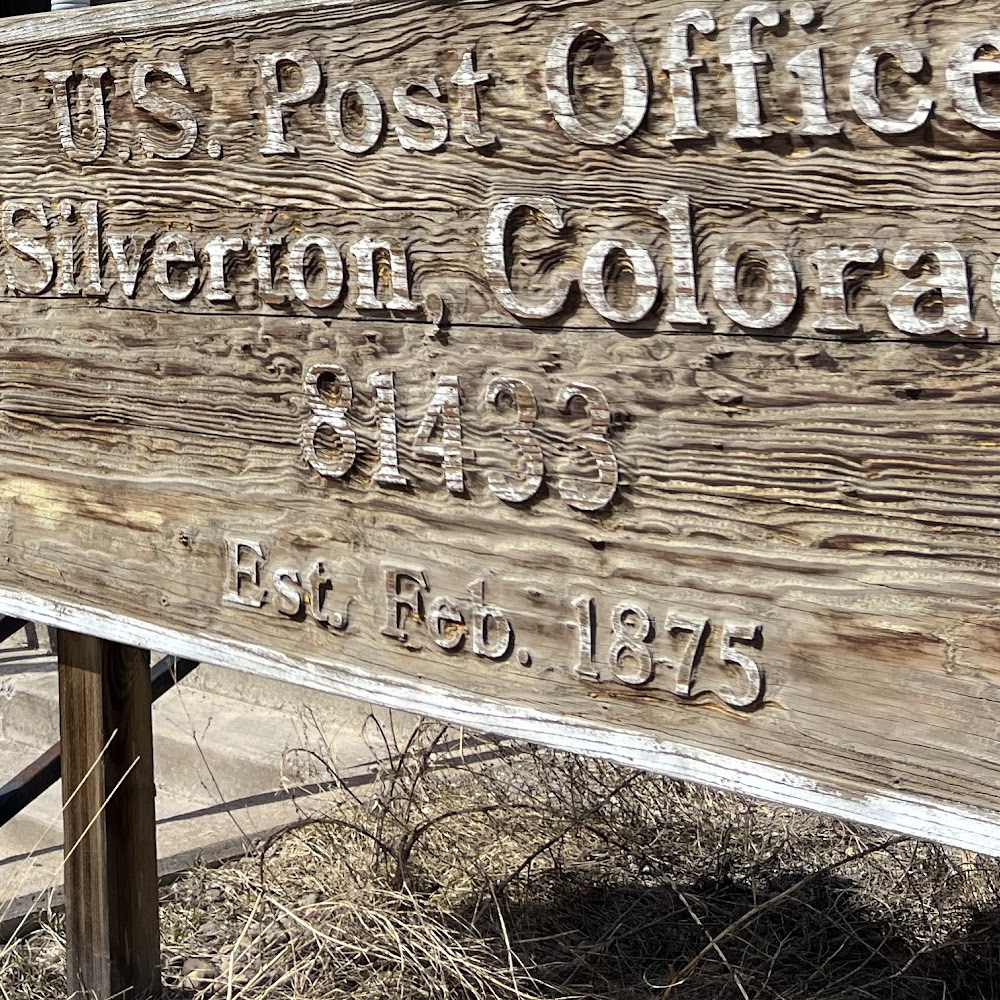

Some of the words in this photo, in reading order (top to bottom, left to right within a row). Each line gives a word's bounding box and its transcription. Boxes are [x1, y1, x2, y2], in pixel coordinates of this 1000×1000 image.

[45, 61, 223, 163] U.S.
[256, 49, 497, 156] Post
[545, 1, 1000, 145] Office
[483, 195, 1000, 339] Colora
[303, 363, 619, 511] 81433
[222, 537, 346, 629] Est.
[381, 562, 532, 666] Feb.
[567, 595, 765, 708] 1875
